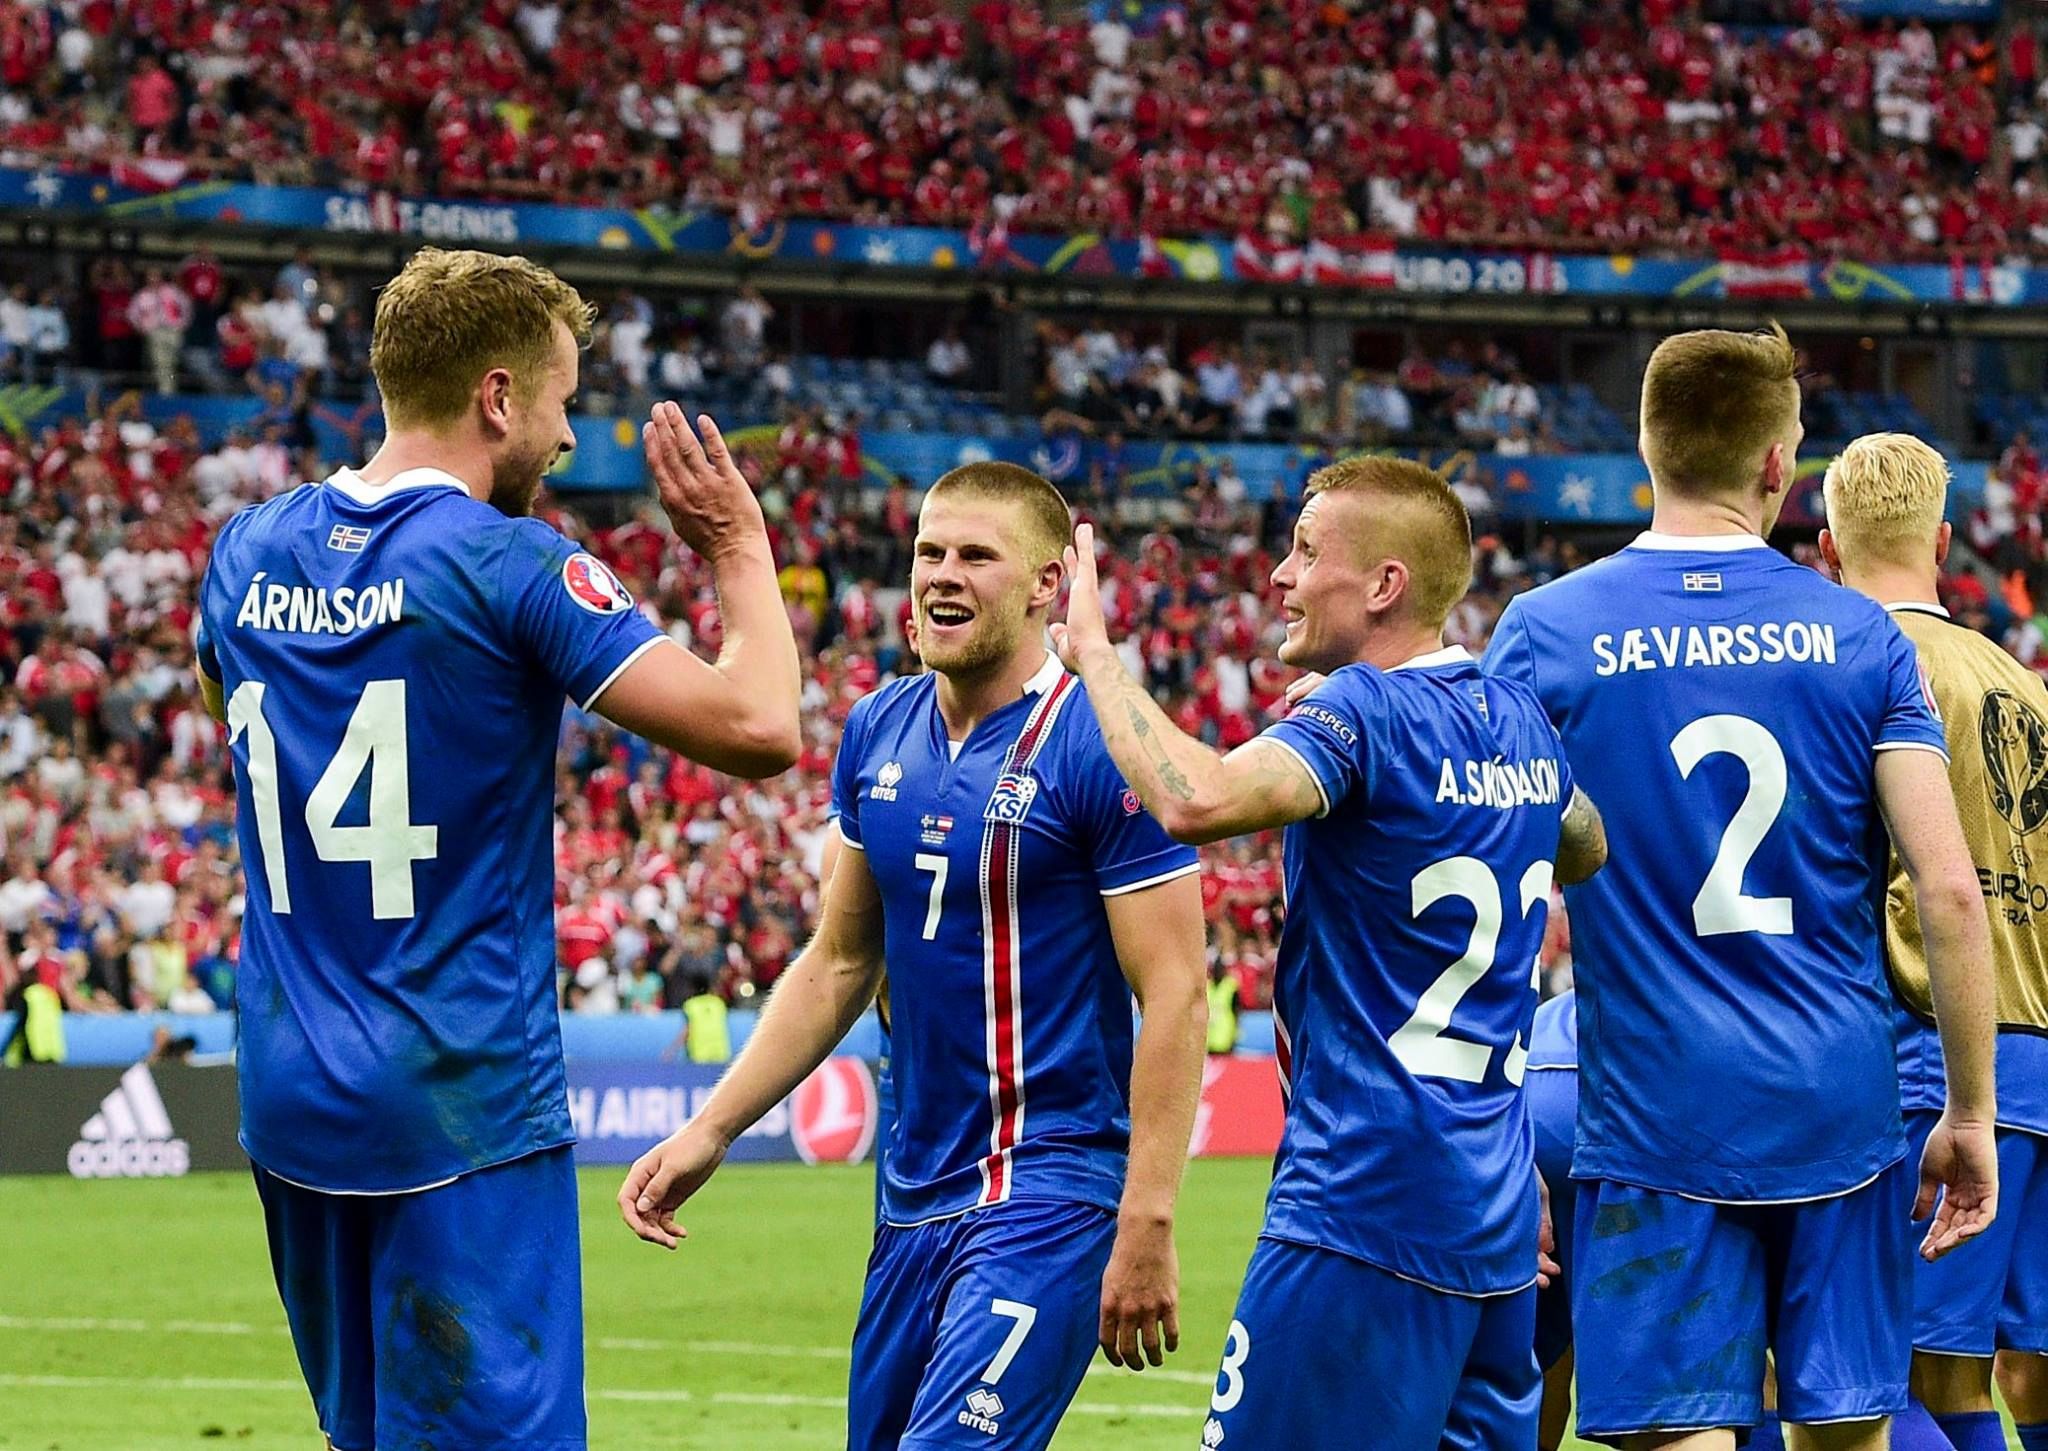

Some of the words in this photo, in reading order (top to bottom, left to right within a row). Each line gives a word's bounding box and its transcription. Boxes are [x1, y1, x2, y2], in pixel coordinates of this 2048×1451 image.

[325, 195, 518, 242] SAT-DENIS
[1394, 256, 1473, 294] URO
[1475, 258, 1569, 294] 206
[236, 572, 404, 634] ÁRNASON
[1592, 621, 1837, 677] SÆVARSSON
[1299, 705, 1358, 745] RESPECT
[227, 679, 438, 919] 14
[1435, 754, 1560, 809] A.SKÚASON
[1670, 714, 1794, 937] 2
[915, 853, 949, 940] 7
[595, 1086, 790, 1138] AIRLS
[66, 1137, 190, 1178] adidas
[980, 1298, 1037, 1386] 7
[958, 1410, 999, 1436] errea
